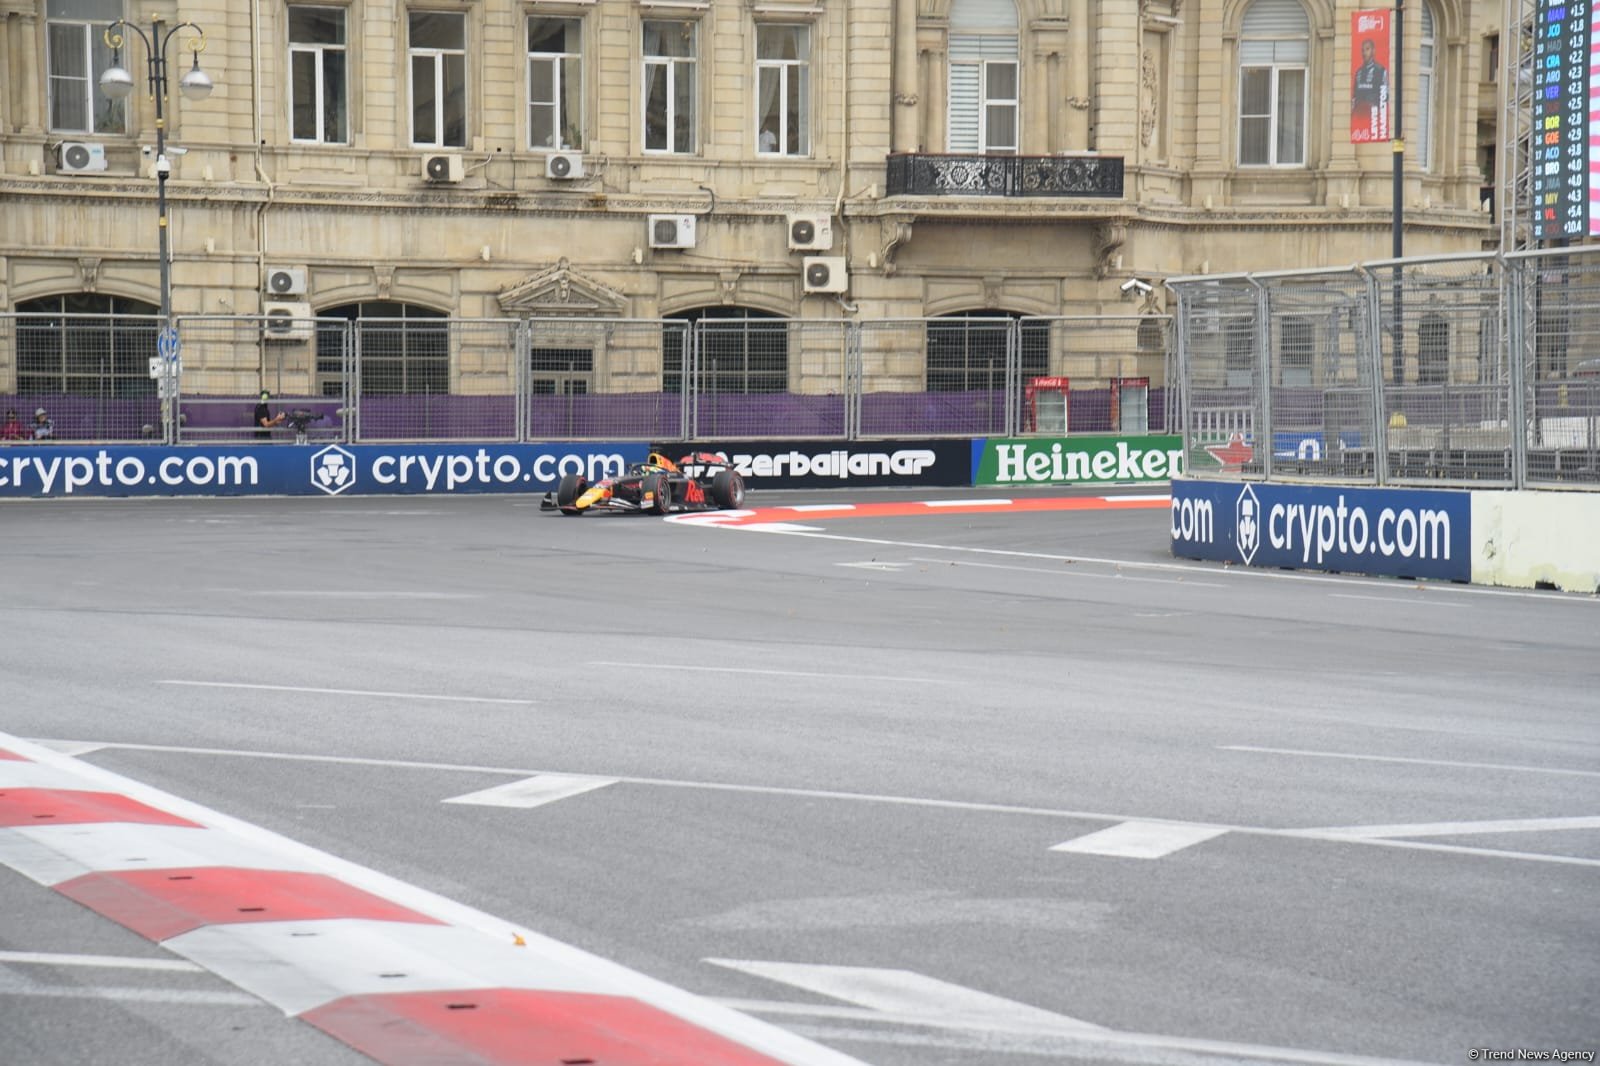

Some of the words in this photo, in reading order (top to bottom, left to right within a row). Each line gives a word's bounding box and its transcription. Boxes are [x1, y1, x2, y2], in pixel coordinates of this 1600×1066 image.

[1547, 7, 1565, 22] MAN
[1571, 3, 1584, 17] +1.5
[1547, 24, 1560, 38] JCO
[1570, 19, 1584, 32] +1.8
[1537, 43, 1544, 55] 10
[1569, 34, 1583, 48] +1.9
[1536, 59, 1542, 69] 11
[1546, 54, 1560, 68] CRA
[1569, 50, 1583, 64] +2.2
[1536, 74, 1542, 84] 12
[1545, 70, 1560, 83] ARO
[1568, 66, 1582, 79] +2.3
[1535, 89, 1542, 100] 13
[1545, 85, 1559, 99] VER
[1568, 81, 1582, 95] +2.3
[1535, 104, 1542, 115] 14
[1568, 96, 1582, 110] +2.5
[1535, 120, 1542, 130] 15
[1545, 115, 1560, 129] BOR
[1568, 112, 1582, 125] +2.8
[1535, 135, 1542, 145] 16
[1545, 131, 1559, 144] GOE
[1568, 128, 1582, 141] +2.9
[1535, 150, 1542, 160] 17
[1545, 146, 1560, 160] ACO
[1545, 161, 1560, 175] BRO
[1535, 195, 1542, 206] 20
[1545, 192, 1558, 205] MIY
[1568, 189, 1582, 202] +4.3
[1534, 210, 1542, 220] 21
[1544, 207, 1556, 220] VIL
[1568, 205, 1582, 218] +5.4
[1534, 225, 1542, 236] 22
[1564, 220, 1582, 234] +10.4
[372, 448, 625, 491] crypto.com
[995, 442, 1184, 482] Heineken
[1269, 494, 1451, 565] crypto.com
